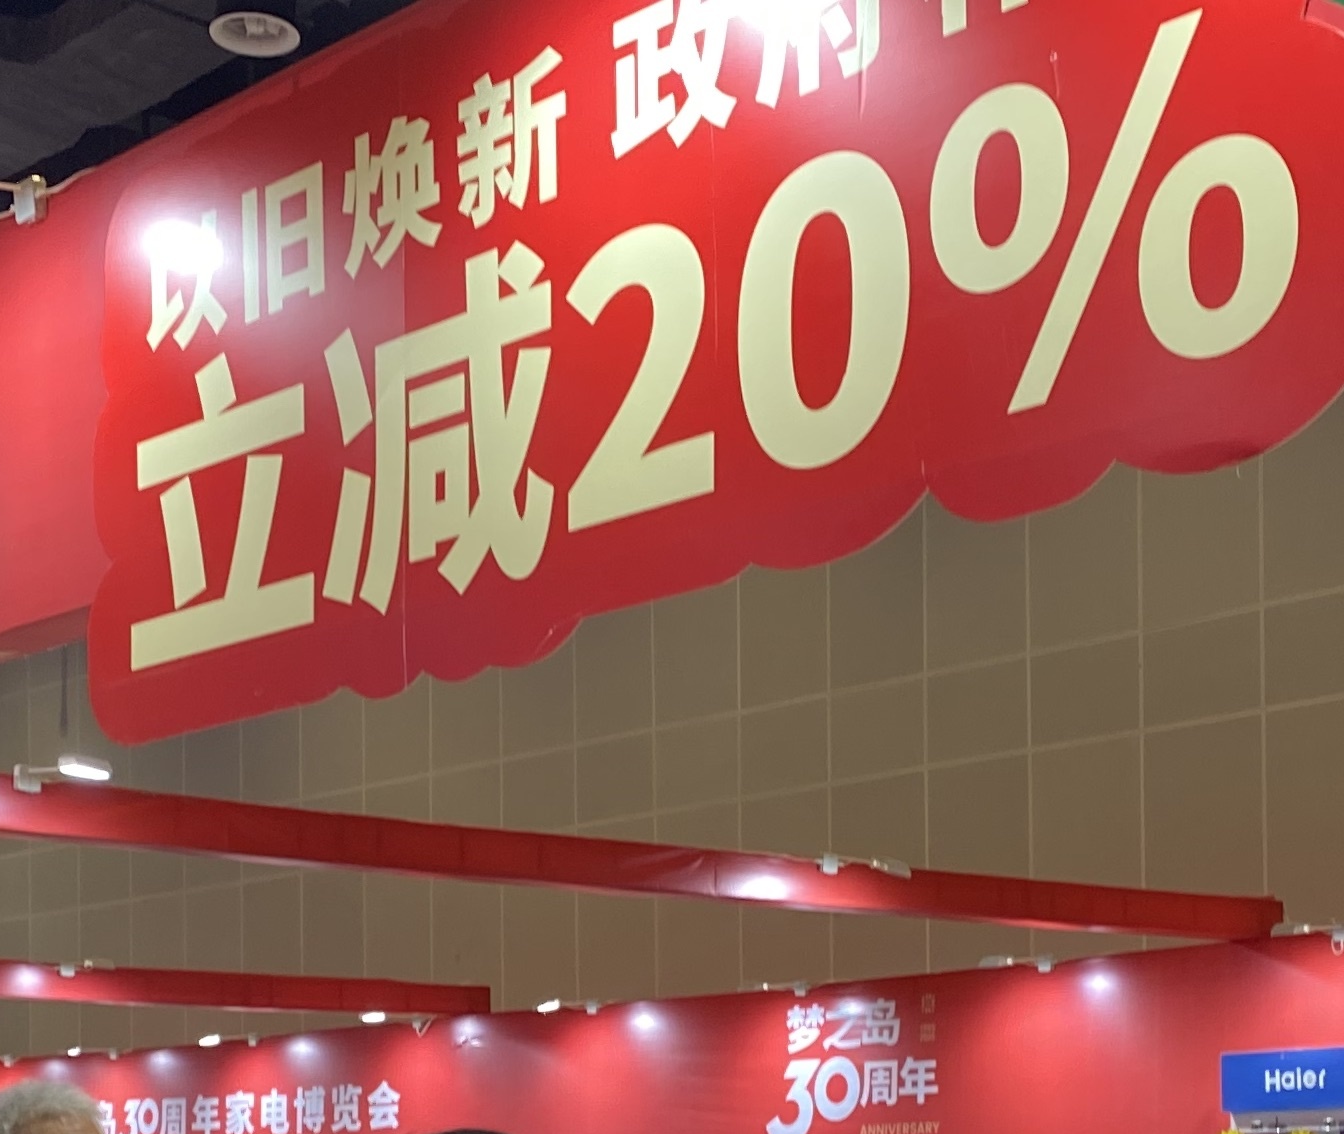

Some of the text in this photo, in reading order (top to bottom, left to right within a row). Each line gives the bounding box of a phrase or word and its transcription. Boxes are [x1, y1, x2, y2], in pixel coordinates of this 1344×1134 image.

[144, 44, 568, 352] 以旧焕新
[129, 8, 1300, 671] 立减20%
[786, 997, 900, 1056] 梦之岛
[1264, 1067, 1326, 1094] Haier
